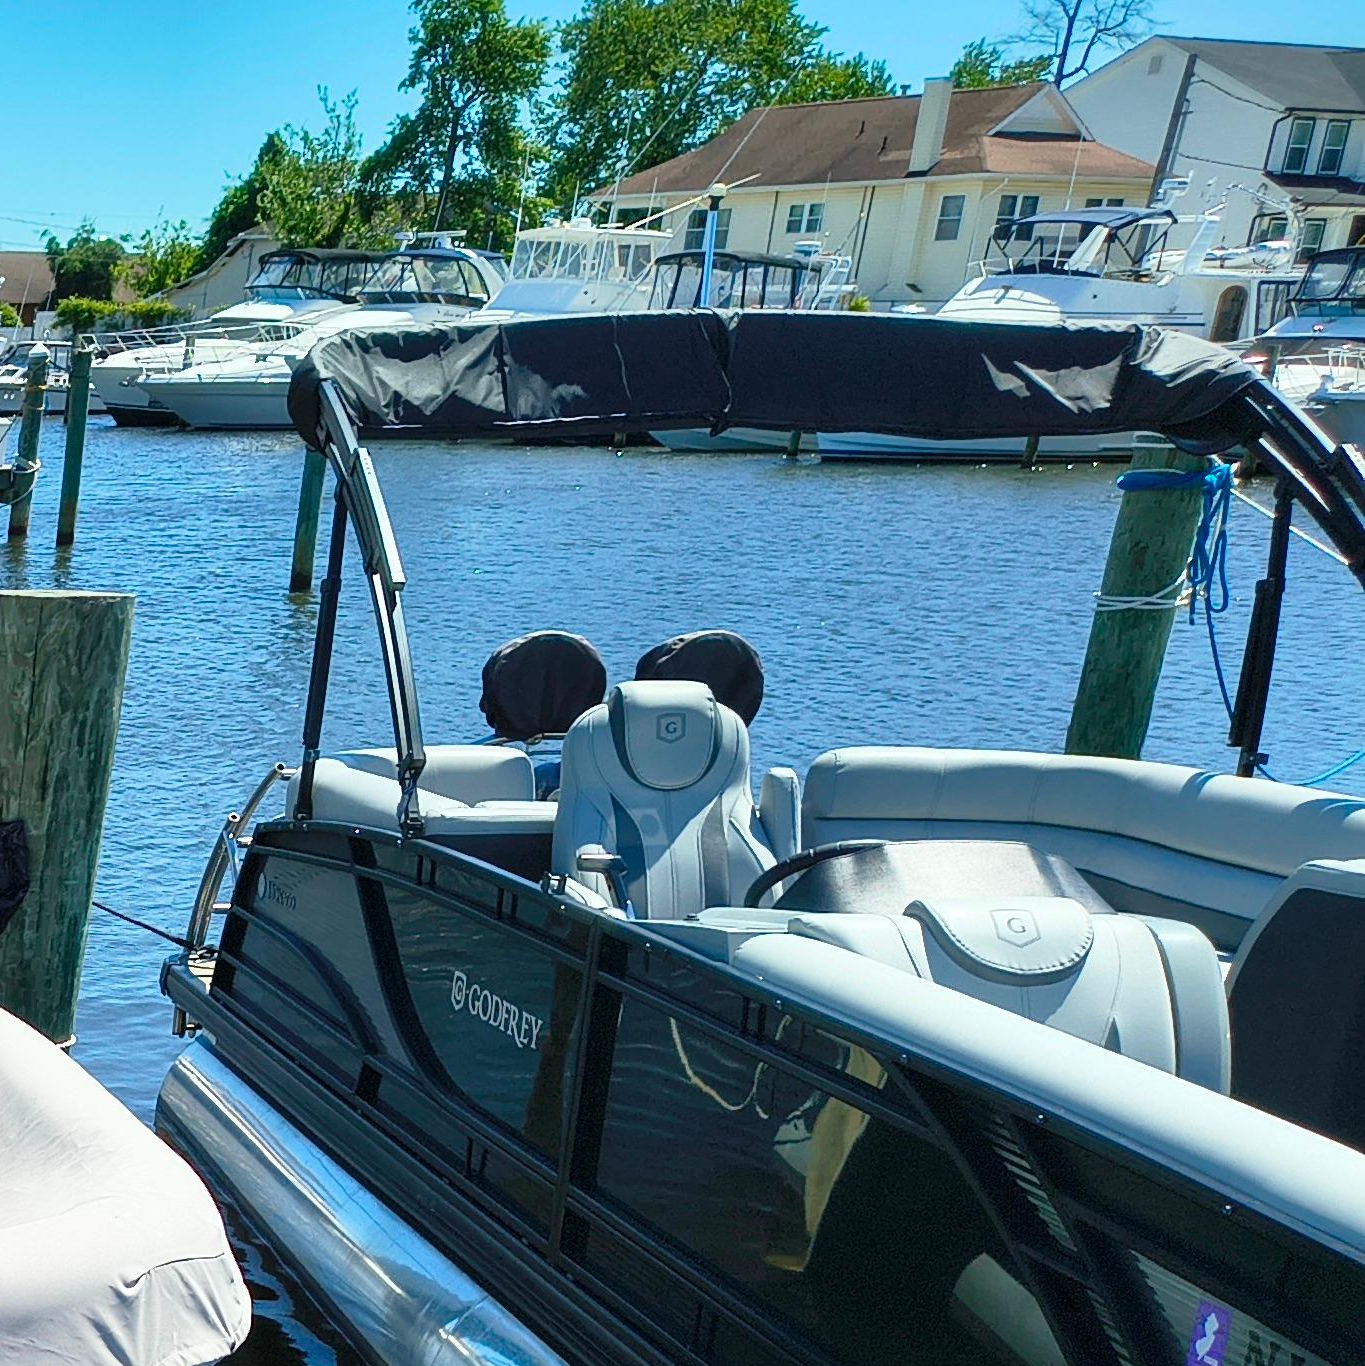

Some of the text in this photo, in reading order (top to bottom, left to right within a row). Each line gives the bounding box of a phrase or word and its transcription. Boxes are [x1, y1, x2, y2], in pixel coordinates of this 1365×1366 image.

[665, 721, 678, 734] G
[1006, 917, 1027, 934] G
[468, 984, 544, 1050] GODFREY
